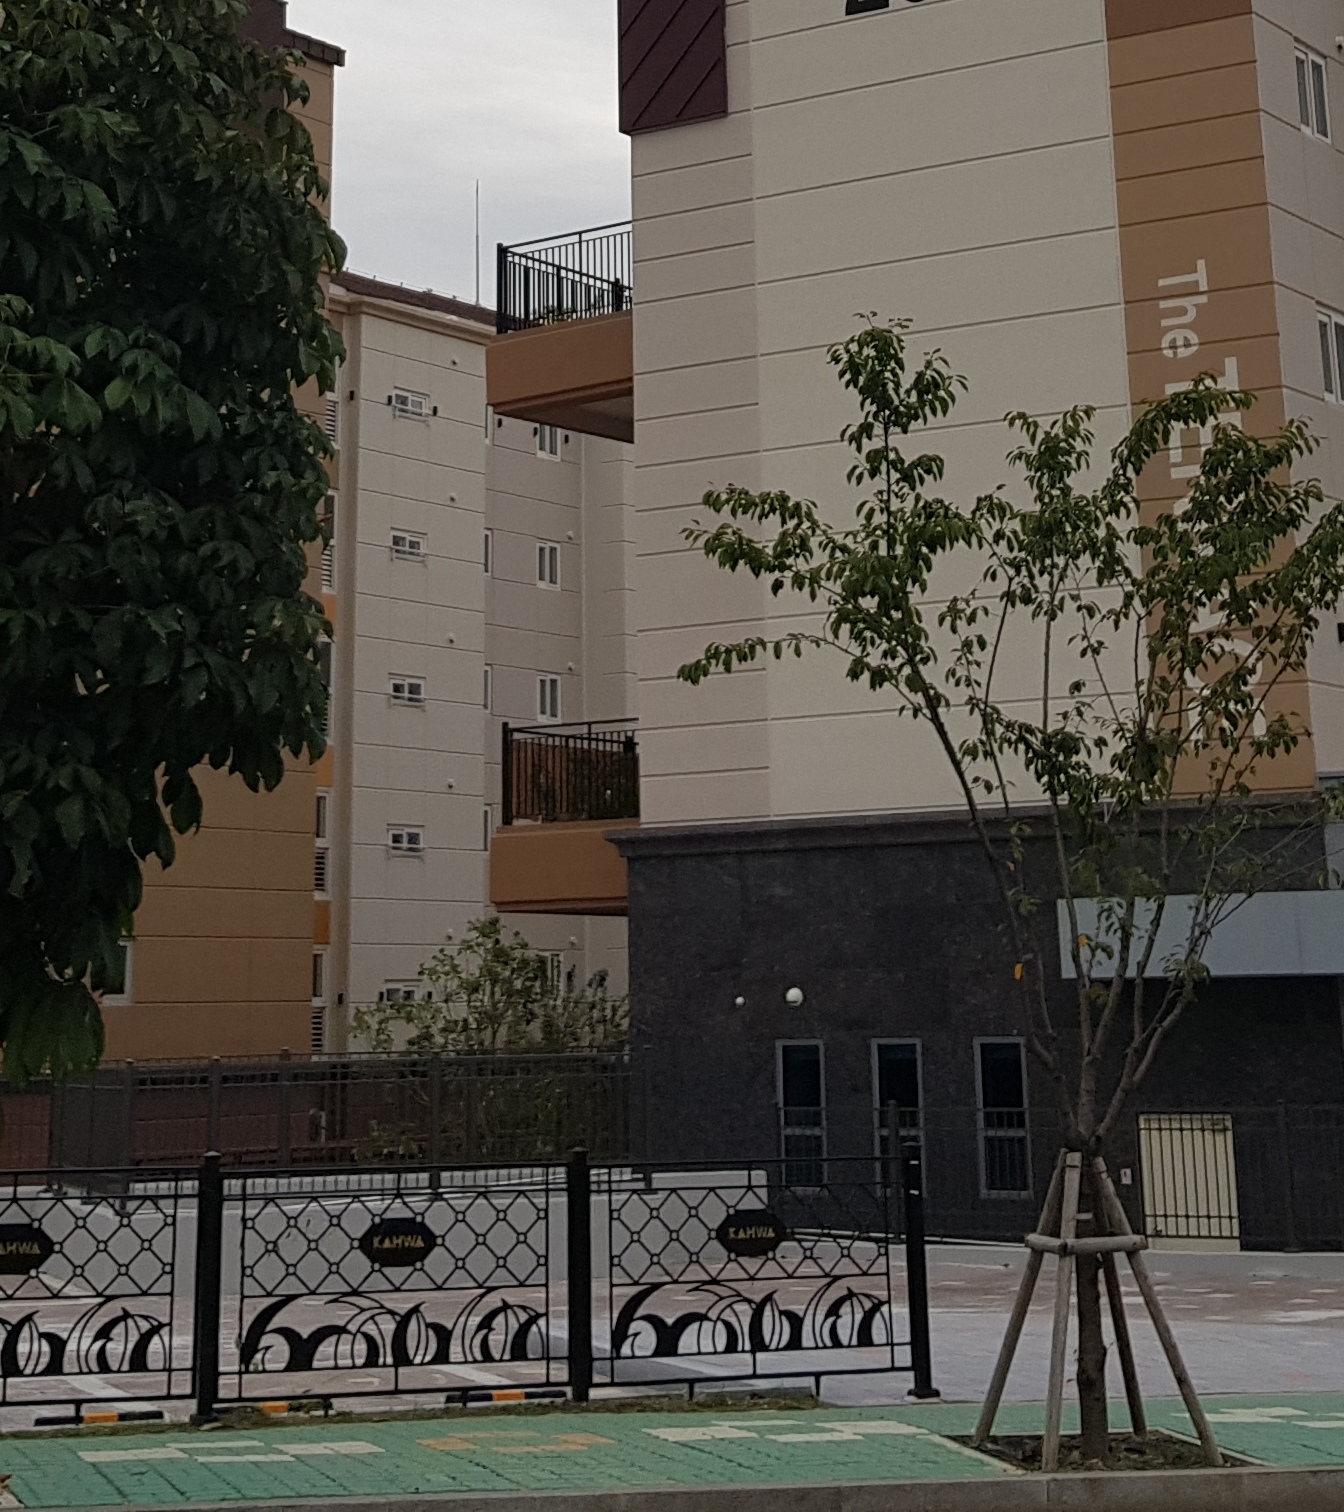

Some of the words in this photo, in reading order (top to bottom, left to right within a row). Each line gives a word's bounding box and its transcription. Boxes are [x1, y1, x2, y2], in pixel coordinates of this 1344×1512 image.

[1157, 258, 1208, 358] The
[728, 1226, 776, 1239] KAHWA
[372, 1235, 425, 1249] KAHWA
